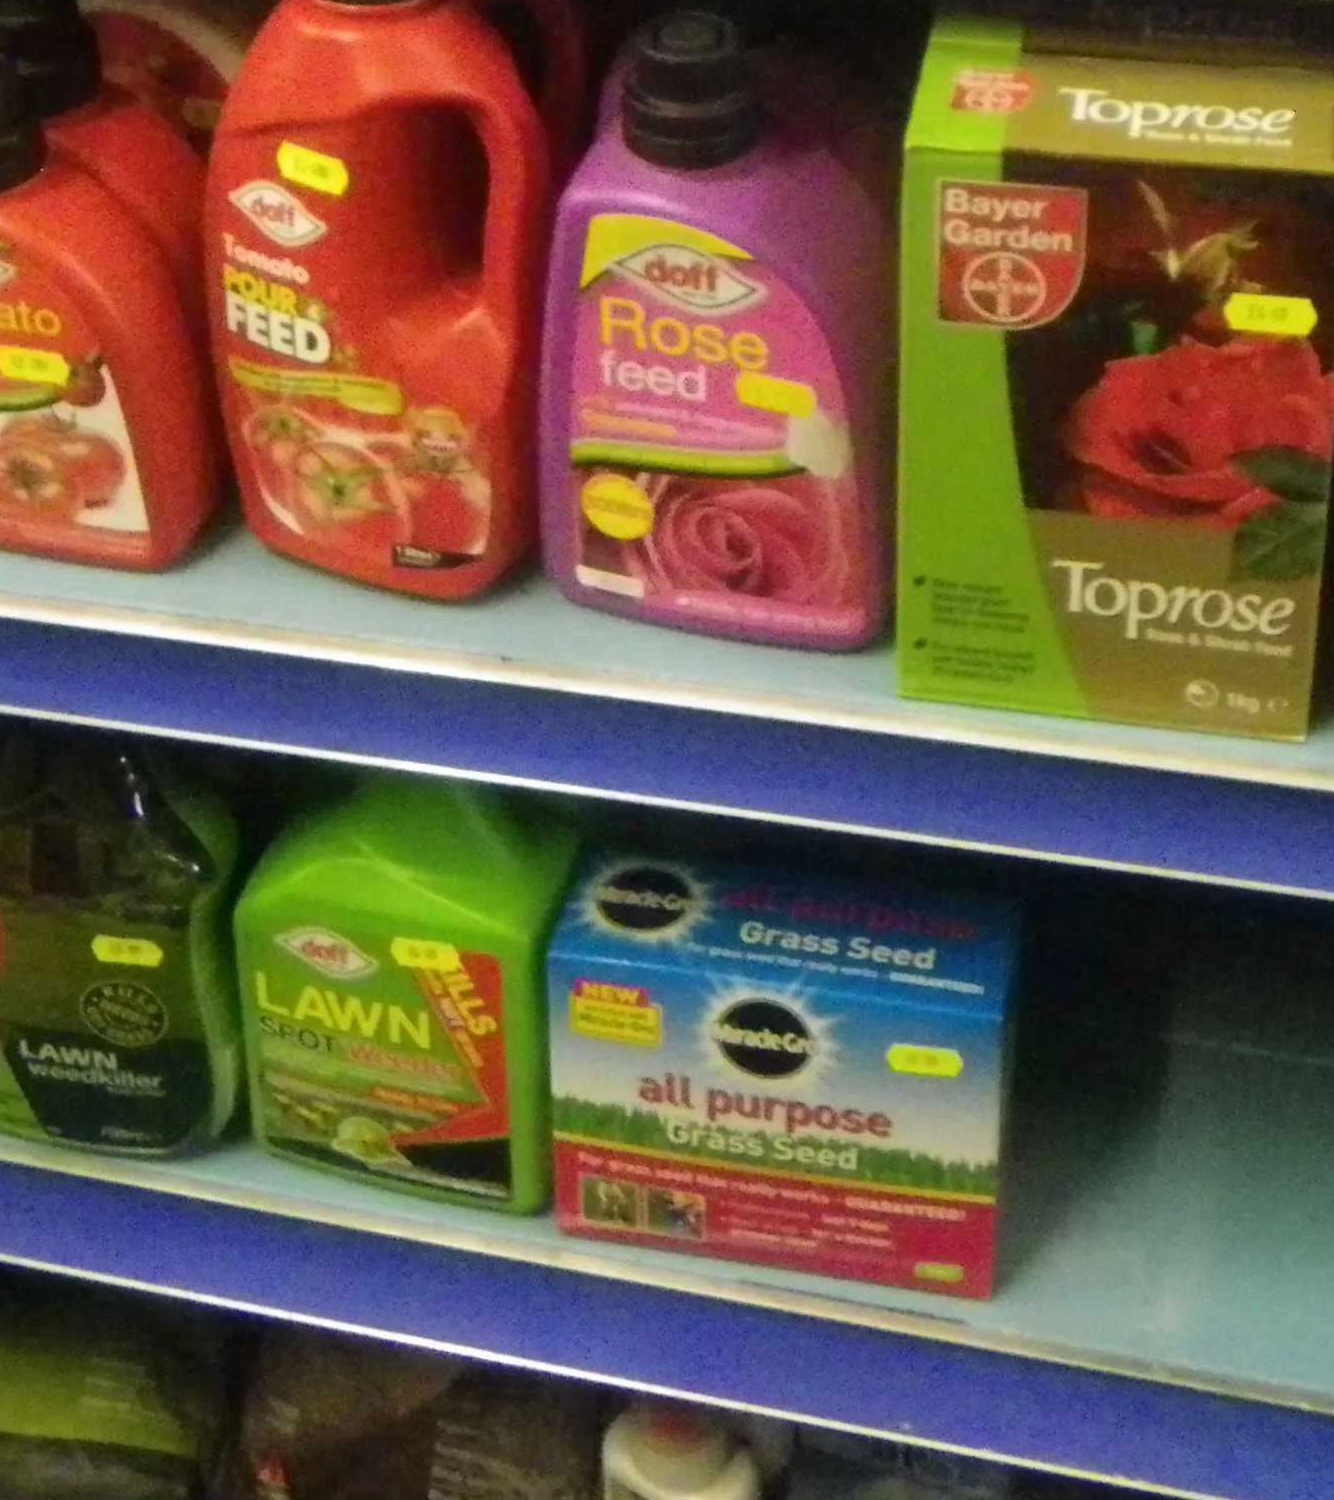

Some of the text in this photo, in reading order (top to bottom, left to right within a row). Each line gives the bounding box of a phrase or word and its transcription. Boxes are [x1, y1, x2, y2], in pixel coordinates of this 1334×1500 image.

[1058, 86, 1296, 139] Toprose
[943, 187, 1049, 221] Bayer
[222, 232, 311, 285] Tomato
[943, 220, 1074, 253] Garden
[222, 263, 299, 313] POUR
[643, 254, 720, 294] doff
[225, 292, 333, 365] FEED
[597, 296, 770, 371] Rose
[598, 349, 708, 402] feed
[1050, 558, 1297, 642] Toprose
[739, 920, 936, 971] Grass Seed
[254, 970, 432, 1050] LAWN
[259, 1014, 338, 1054] SPOT
[18, 1038, 118, 1071] LAWN
[27, 1060, 163, 1089] weedkiller
[638, 1073, 895, 1139] all purpose
[665, 1116, 860, 1172] Grass Seed
